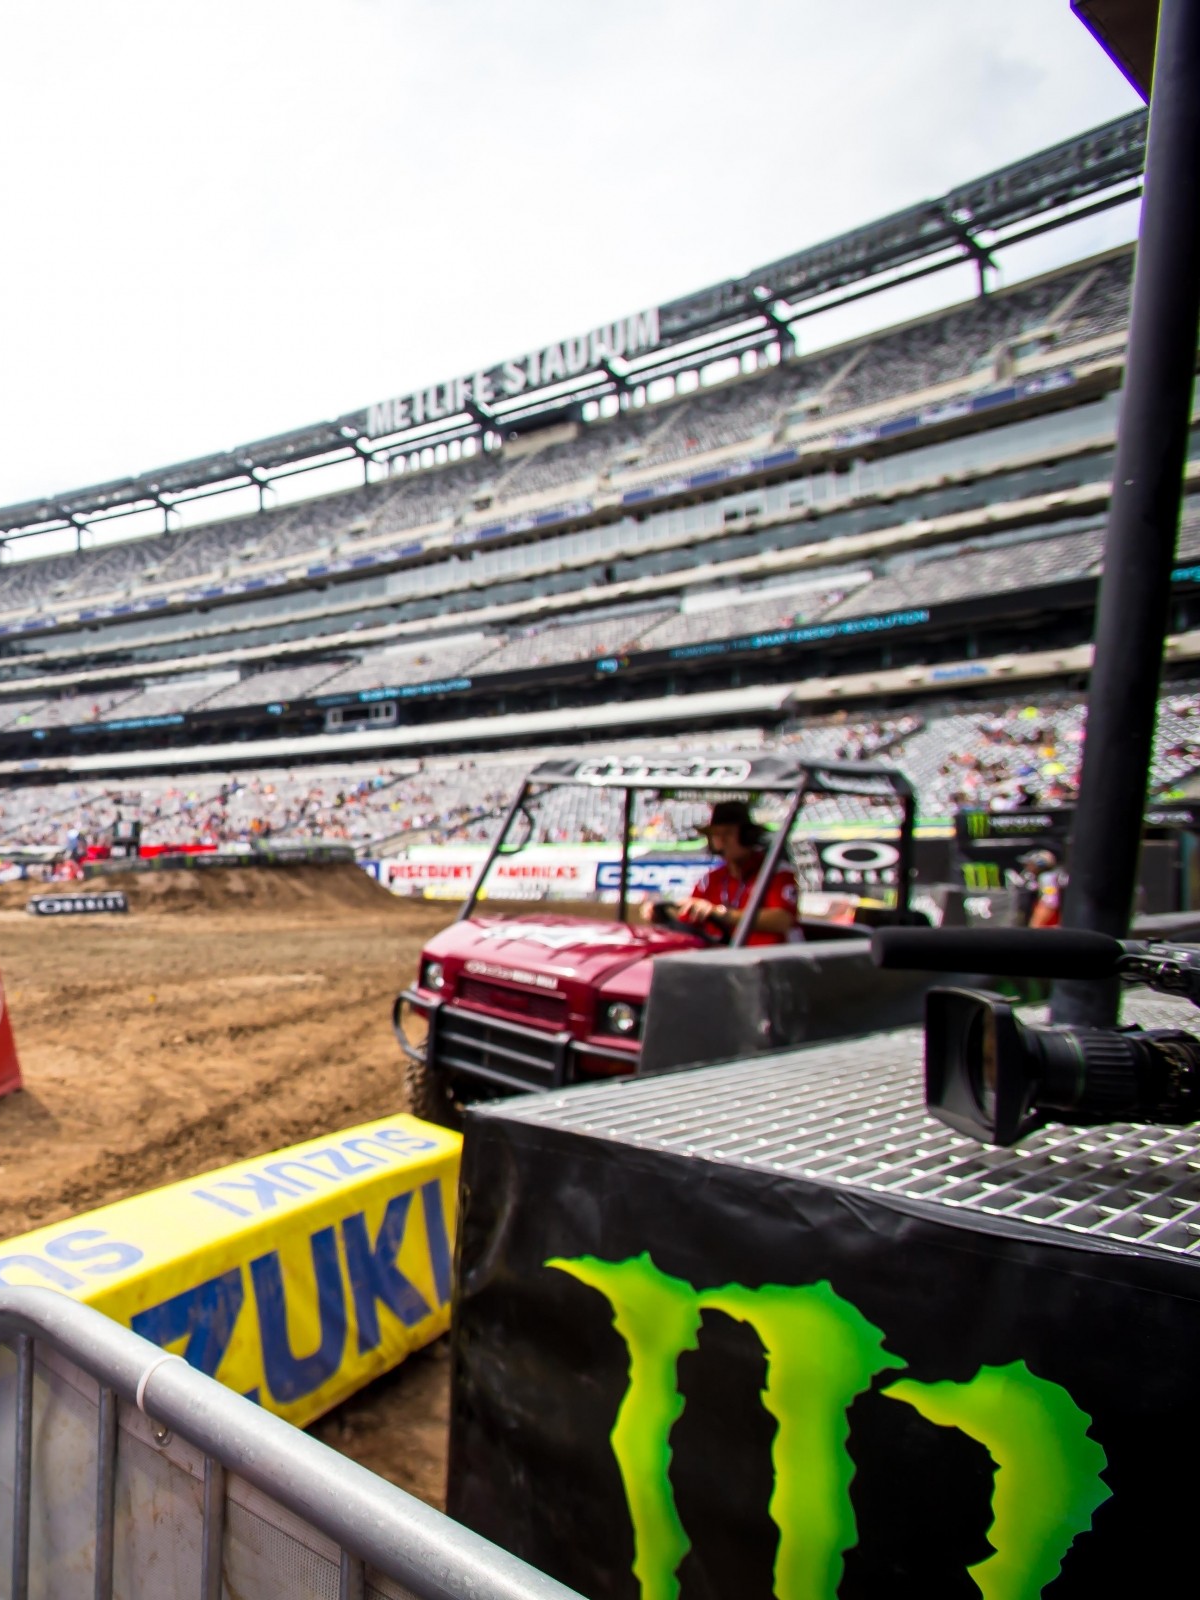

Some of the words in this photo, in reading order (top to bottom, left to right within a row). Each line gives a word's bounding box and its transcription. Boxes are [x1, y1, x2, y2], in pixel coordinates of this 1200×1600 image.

[366, 368, 495, 438] METLIFE
[500, 306, 661, 396] STADIUM
[388, 864, 474, 880] DISCOUNT
[191, 1129, 438, 1219] SUZUKI
[131, 1178, 452, 1405] ZUKI
